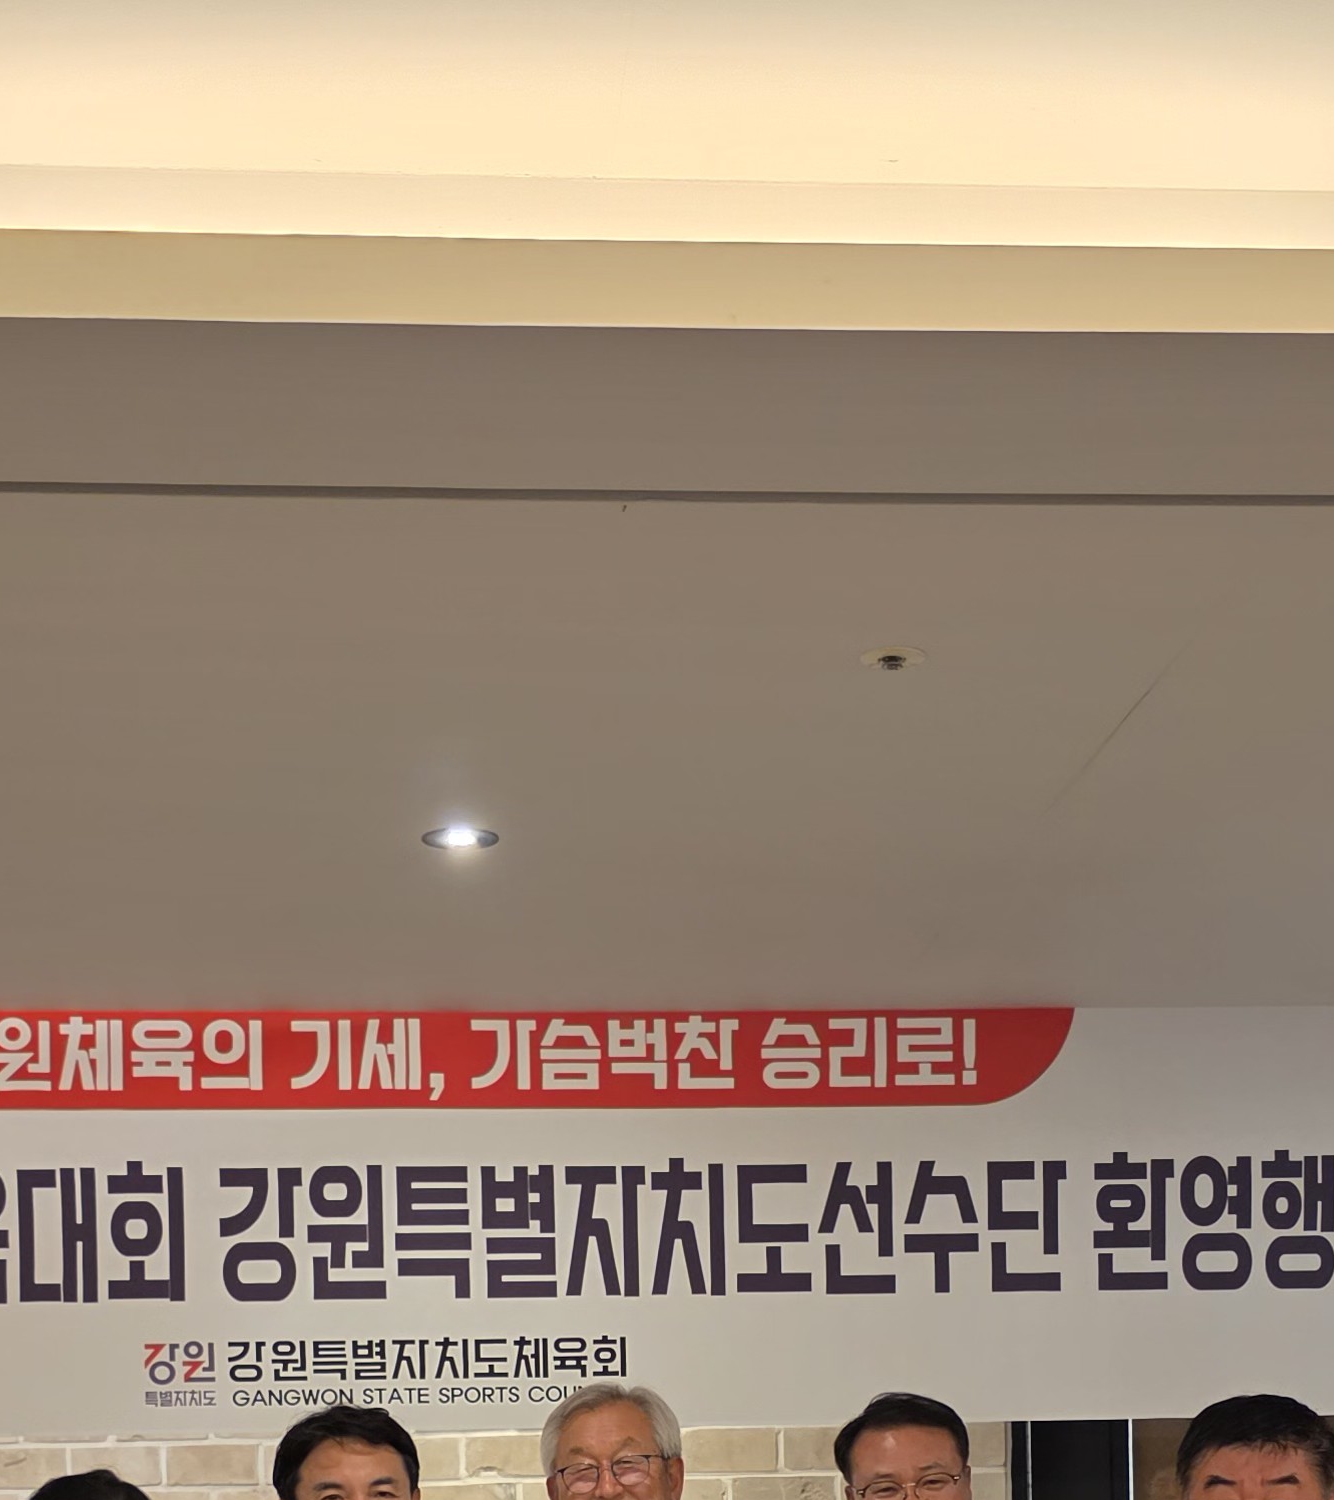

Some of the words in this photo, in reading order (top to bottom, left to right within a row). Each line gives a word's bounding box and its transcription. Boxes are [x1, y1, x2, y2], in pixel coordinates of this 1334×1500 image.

[290, 1017, 445, 1101] 기세,
[470, 1015, 739, 1091] 가슴벅찬
[760, 1017, 977, 1090] 승리로!
[219, 1157, 1068, 1302] 강원특별자치도선수단
[144, 1340, 216, 1386] 강원
[227, 1335, 627, 1383] 강원특별자치도체육회
[144, 1389, 217, 1408] 특별자치도
[232, 1388, 354, 1407] GANGWON
[362, 1387, 430, 1405] STATE
[438, 1386, 520, 1404] SPORTS
